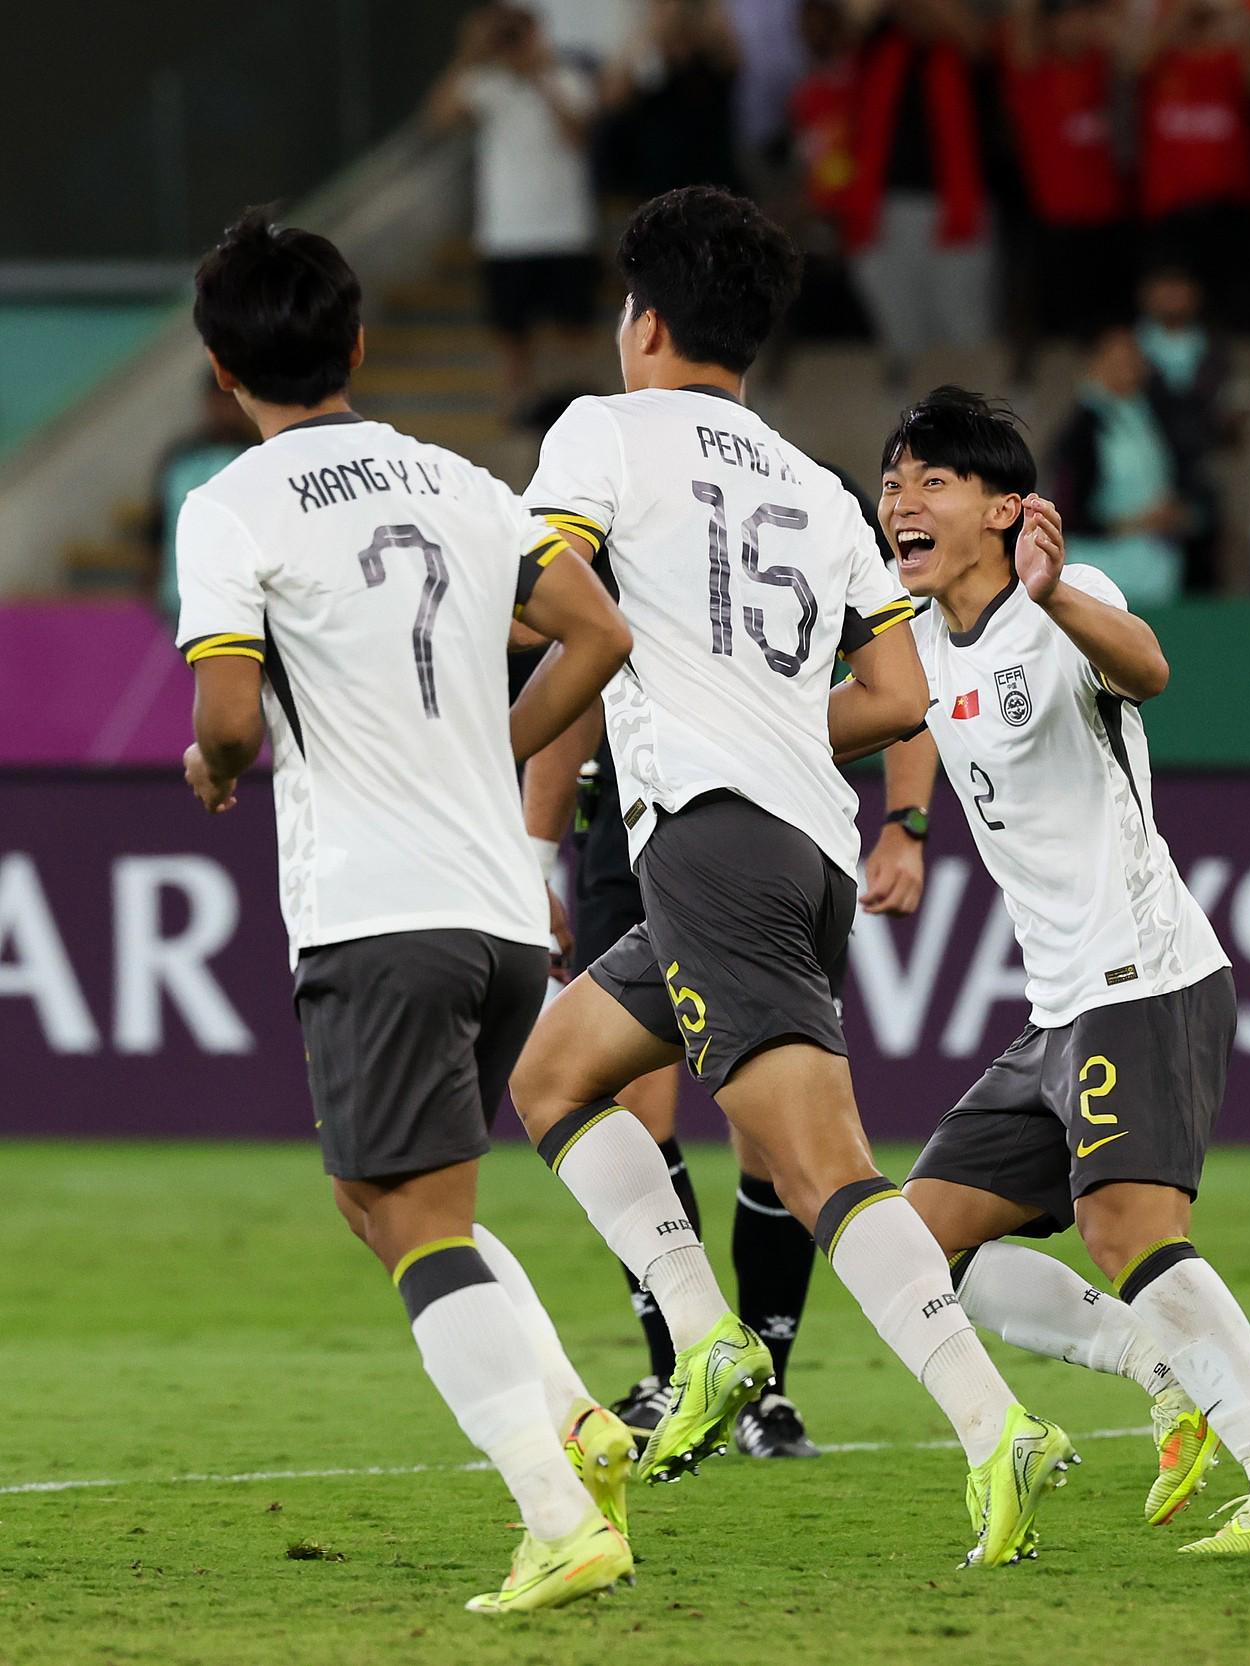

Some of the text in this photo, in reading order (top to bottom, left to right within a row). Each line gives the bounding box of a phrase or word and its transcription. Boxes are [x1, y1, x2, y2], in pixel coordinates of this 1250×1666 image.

[288, 457, 391, 513] XIANG
[696, 426, 770, 477] PENG
[691, 480, 818, 678] 15
[358, 523, 450, 720] 7
[997, 670, 1023, 686] CFA
[970, 761, 1006, 831] 2
[1078, 1054, 1120, 1126] 2
